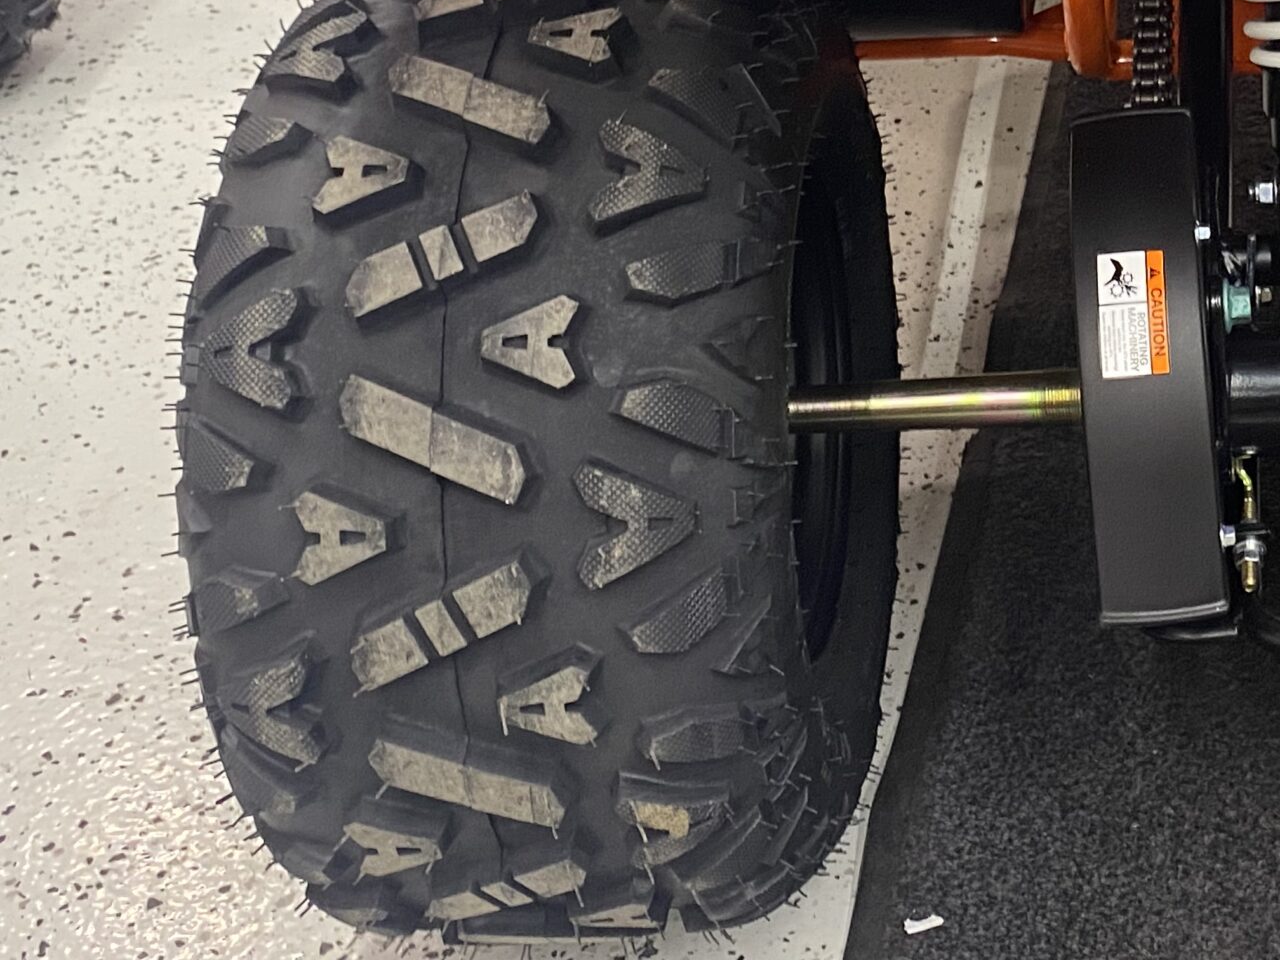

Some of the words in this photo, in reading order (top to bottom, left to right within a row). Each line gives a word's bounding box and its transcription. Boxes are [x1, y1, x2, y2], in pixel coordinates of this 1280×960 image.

[1127, 306, 1140, 373] MACHINERY
[1137, 311, 1149, 367] ROTATING
[1150, 287, 1166, 358] CAUTION
